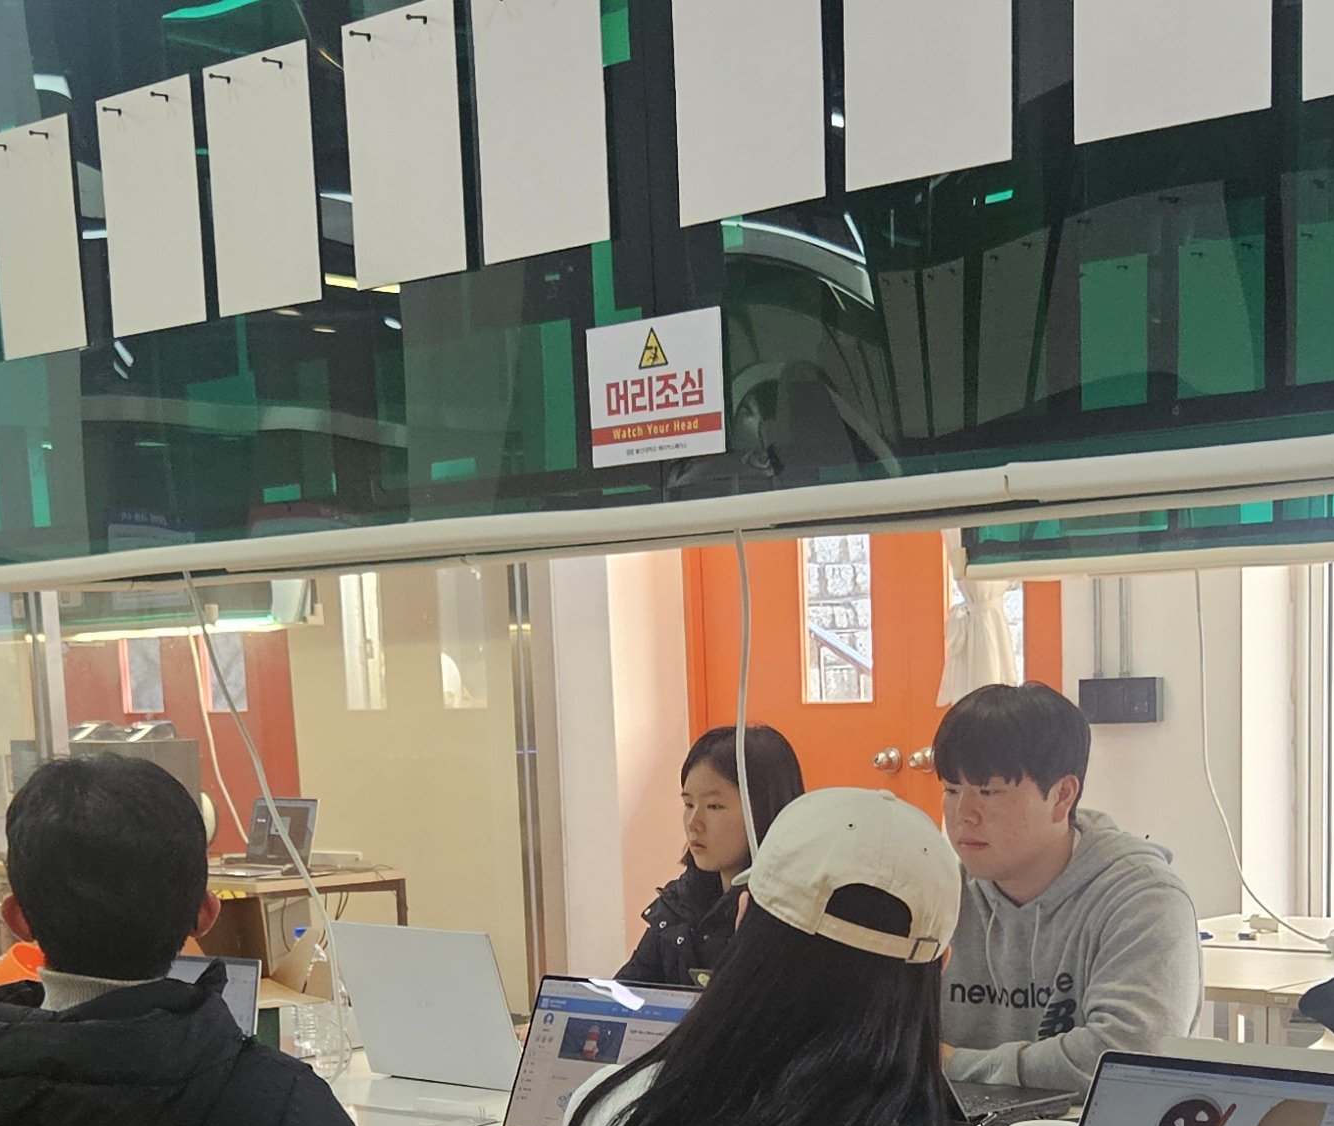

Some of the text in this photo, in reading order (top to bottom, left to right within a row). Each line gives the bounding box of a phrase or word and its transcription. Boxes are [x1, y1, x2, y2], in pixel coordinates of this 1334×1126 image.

[606, 368, 704, 416] 머리조심
[612, 418, 699, 440] Watch Your Head
